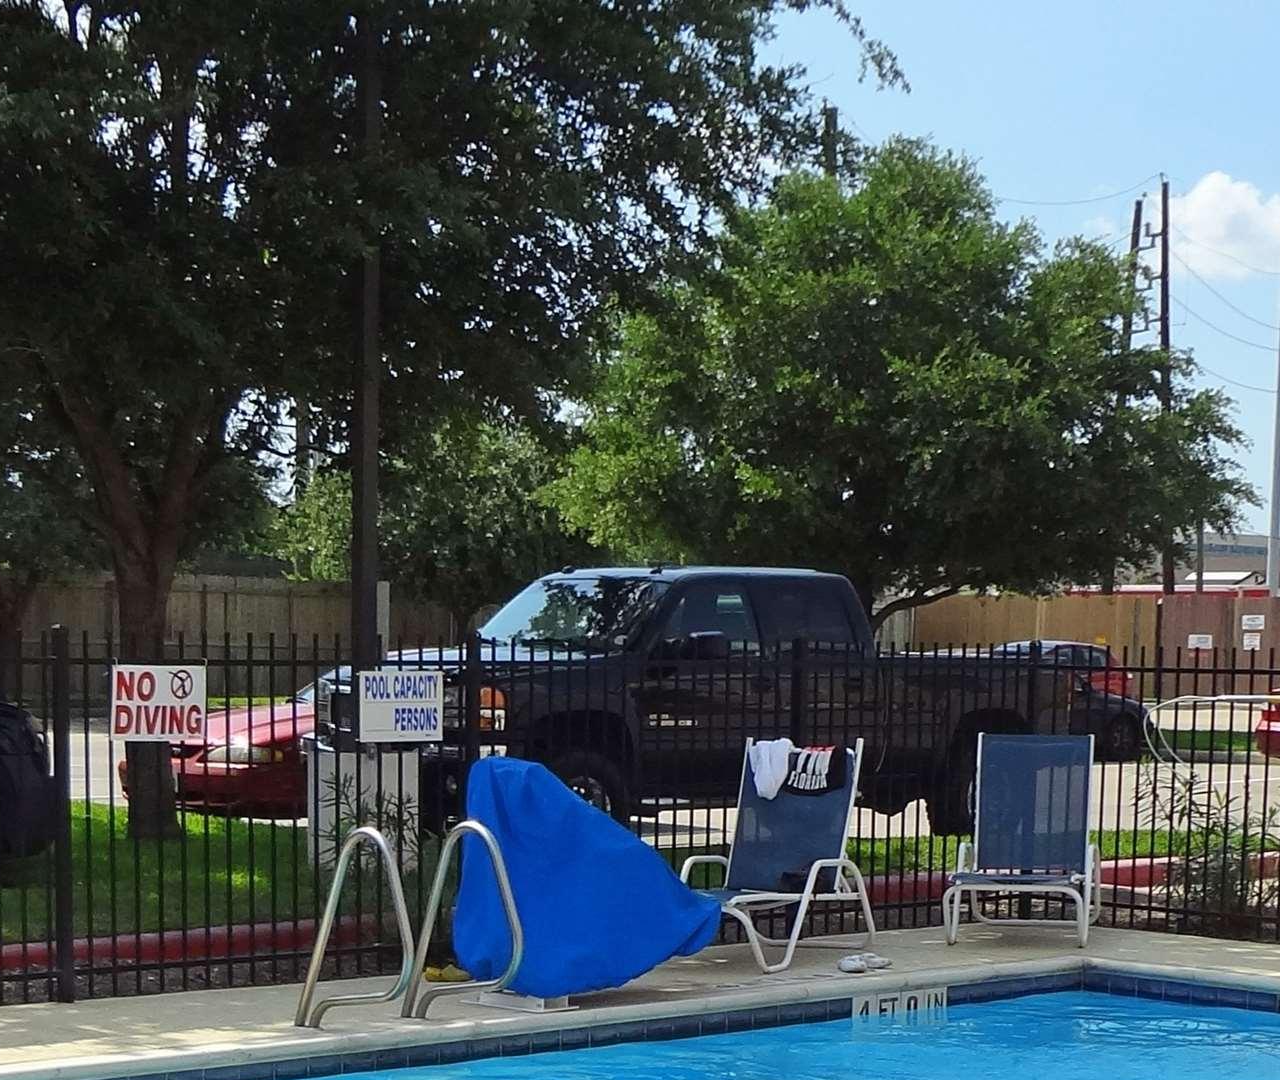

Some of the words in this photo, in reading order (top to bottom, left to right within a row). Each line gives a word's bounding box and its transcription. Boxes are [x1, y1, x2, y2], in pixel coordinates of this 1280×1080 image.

[117, 671, 156, 701] NO
[364, 676, 390, 699] POOL
[393, 675, 438, 699] CAPACITY
[114, 704, 202, 734] DIVING
[394, 707, 438, 731] PERSONS
